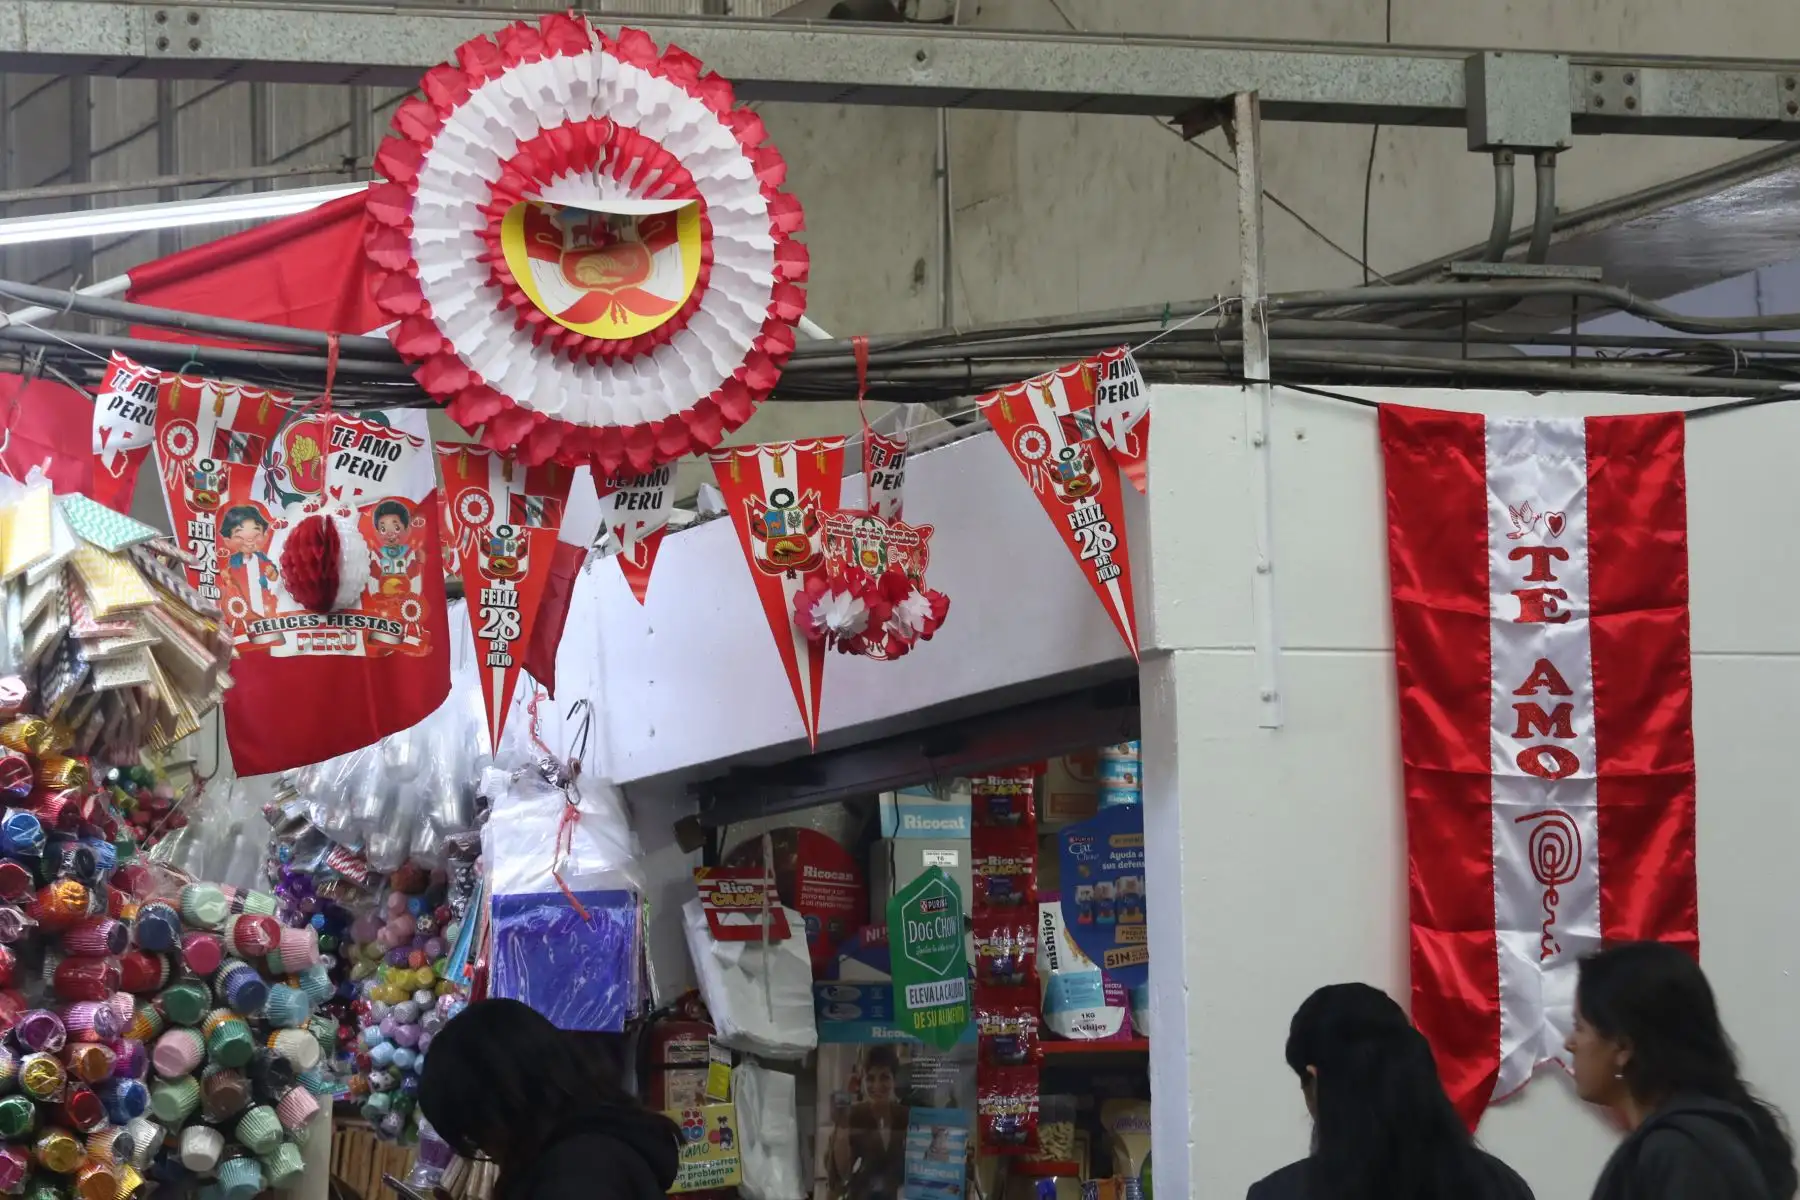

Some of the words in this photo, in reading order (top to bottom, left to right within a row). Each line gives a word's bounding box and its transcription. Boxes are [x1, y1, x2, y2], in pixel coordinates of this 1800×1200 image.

[111, 369, 133, 391] TE
[131, 382, 158, 402] AM
[332, 426, 356, 448] TE
[357, 435, 402, 462] AMO
[871, 444, 887, 466] TE
[334, 452, 388, 482] PERÚ
[870, 471, 905, 490] PER
[614, 487, 663, 510] PERÚ
[1067, 504, 1106, 531] FELIZ
[188, 520, 216, 543] FELI
[1074, 521, 1118, 561] 28
[1094, 555, 1112, 569] DE
[200, 573, 215, 586] DE
[1095, 564, 1122, 584] JULIO
[1507, 545, 1571, 625] TE
[480, 588, 518, 608] FELIZ
[253, 614, 319, 635] FELICES
[326, 613, 402, 635] FIESTAS
[478, 607, 521, 642] 28
[489, 640, 508, 653] DE
[486, 653, 513, 668] JULIO
[1511, 656, 1580, 780] AMO
[987, 775, 1014, 786] Rico
[903, 814, 965, 830] Ricocat
[1068, 842, 1093, 855] Cat
[1109, 850, 1137, 861] Ayuda
[988, 855, 1014, 866] Rico
[1102, 862, 1116, 870] sus
[803, 865, 854, 882] Ricocan
[718, 881, 755, 894] Rico
[908, 920, 933, 944] DOG
[935, 915, 957, 939] CHOW
[1043, 911, 1059, 970] mishijoy
[1107, 951, 1131, 966] SIN
[909, 988, 933, 1005] ELEVA
[935, 985, 945, 1002] LA
[914, 1011, 928, 1029] DE
[928, 1009, 938, 1027] SU
[687, 1168, 734, 1181] problemas
